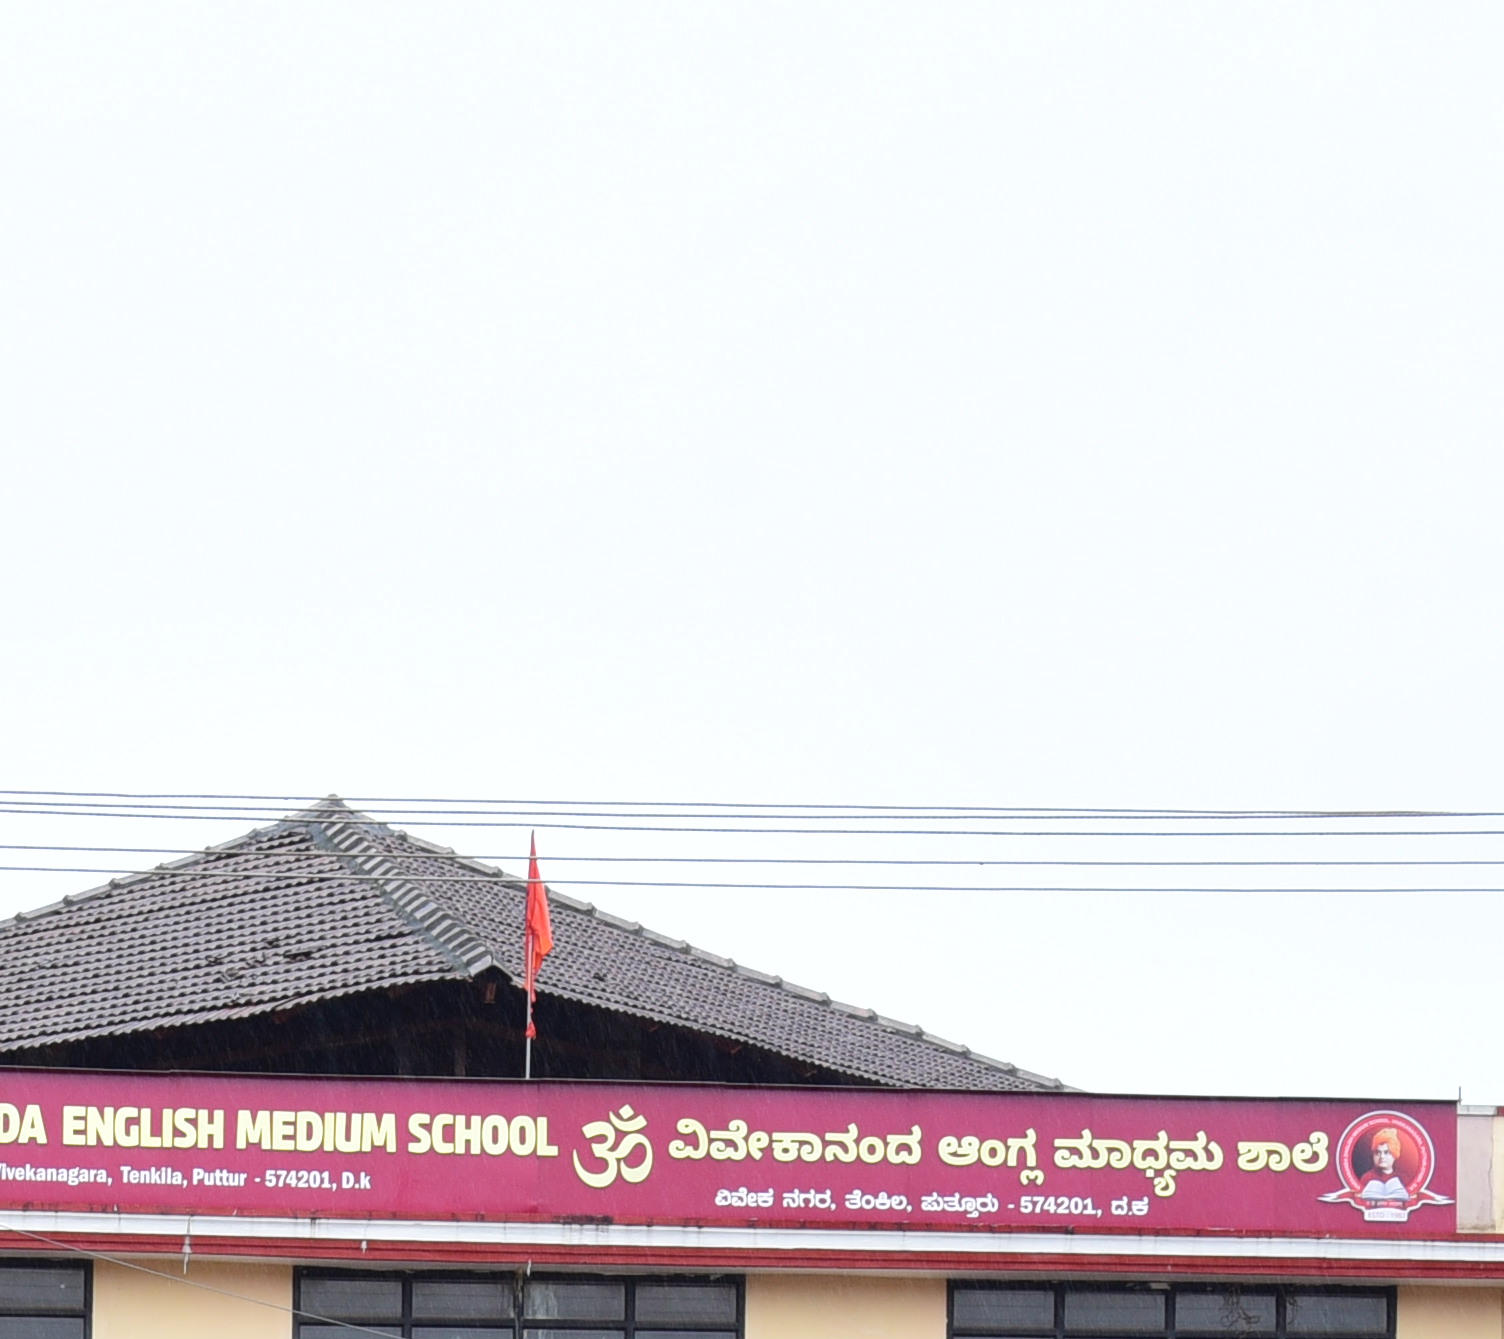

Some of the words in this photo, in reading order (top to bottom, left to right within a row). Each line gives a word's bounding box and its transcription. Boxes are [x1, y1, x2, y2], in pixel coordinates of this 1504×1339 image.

[62, 1105, 225, 1149] ENGLISH
[235, 1109, 397, 1153] MEDIUM
[407, 1112, 559, 1157] SCHOOL
[119, 1165, 188, 1188] Tenkila,
[192, 1167, 248, 1187] Puttur
[264, 1169, 337, 1192] 574201,
[341, 1171, 371, 1190] D.k
[668, 1118, 922, 1165] ವಿವೇಕಾನಂದ
[937, 1127, 1045, 1186] ಆಂಗ್ಲ
[1052, 1128, 1224, 1198] ಮಾಧ್ಯಮ
[1237, 1131, 1329, 1173] ಶಾಲೆ
[714, 1186, 775, 1208] ವಿವೇಕ
[782, 1188, 837, 1211] ನಗರ,
[844, 1189, 913, 1213] ತೆಂಕಿಲ,
[920, 1193, 999, 1218] ಪುತ್ತೂರು
[1019, 1195, 1103, 1218] 574201,
